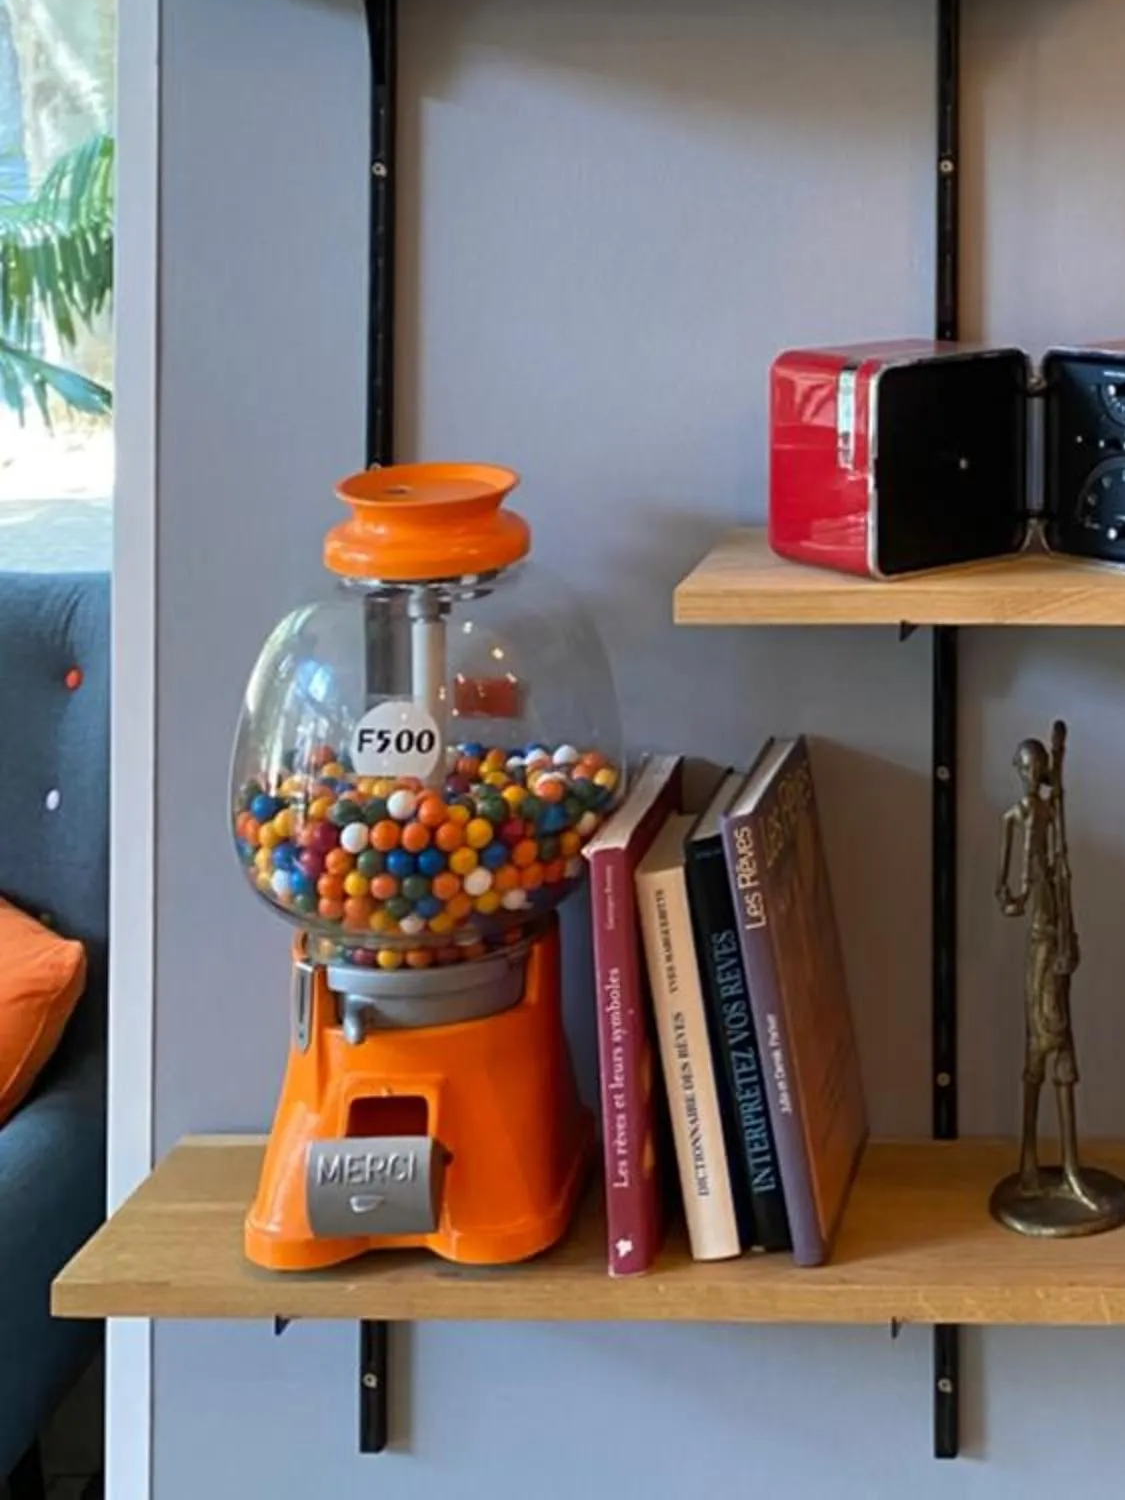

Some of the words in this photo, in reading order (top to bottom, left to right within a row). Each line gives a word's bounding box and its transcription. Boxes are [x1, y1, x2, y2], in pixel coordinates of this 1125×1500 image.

[357, 728, 436, 755] F500
[733, 826, 761, 890] Rêves
[744, 891, 767, 930] Les
[711, 928, 745, 997] RÊVES
[604, 966, 629, 1043] symboles
[722, 1001, 751, 1045] VOS
[673, 1011, 690, 1059] RÊVES
[608, 1046, 625, 1090] leurs
[679, 1061, 695, 1091] DES
[613, 1093, 625, 1110] et
[612, 1113, 629, 1156] rêves
[684, 1095, 710, 1197] DICTIONNAIRE
[317, 1150, 417, 1185] MERCI
[613, 1160, 629, 1188] Les
